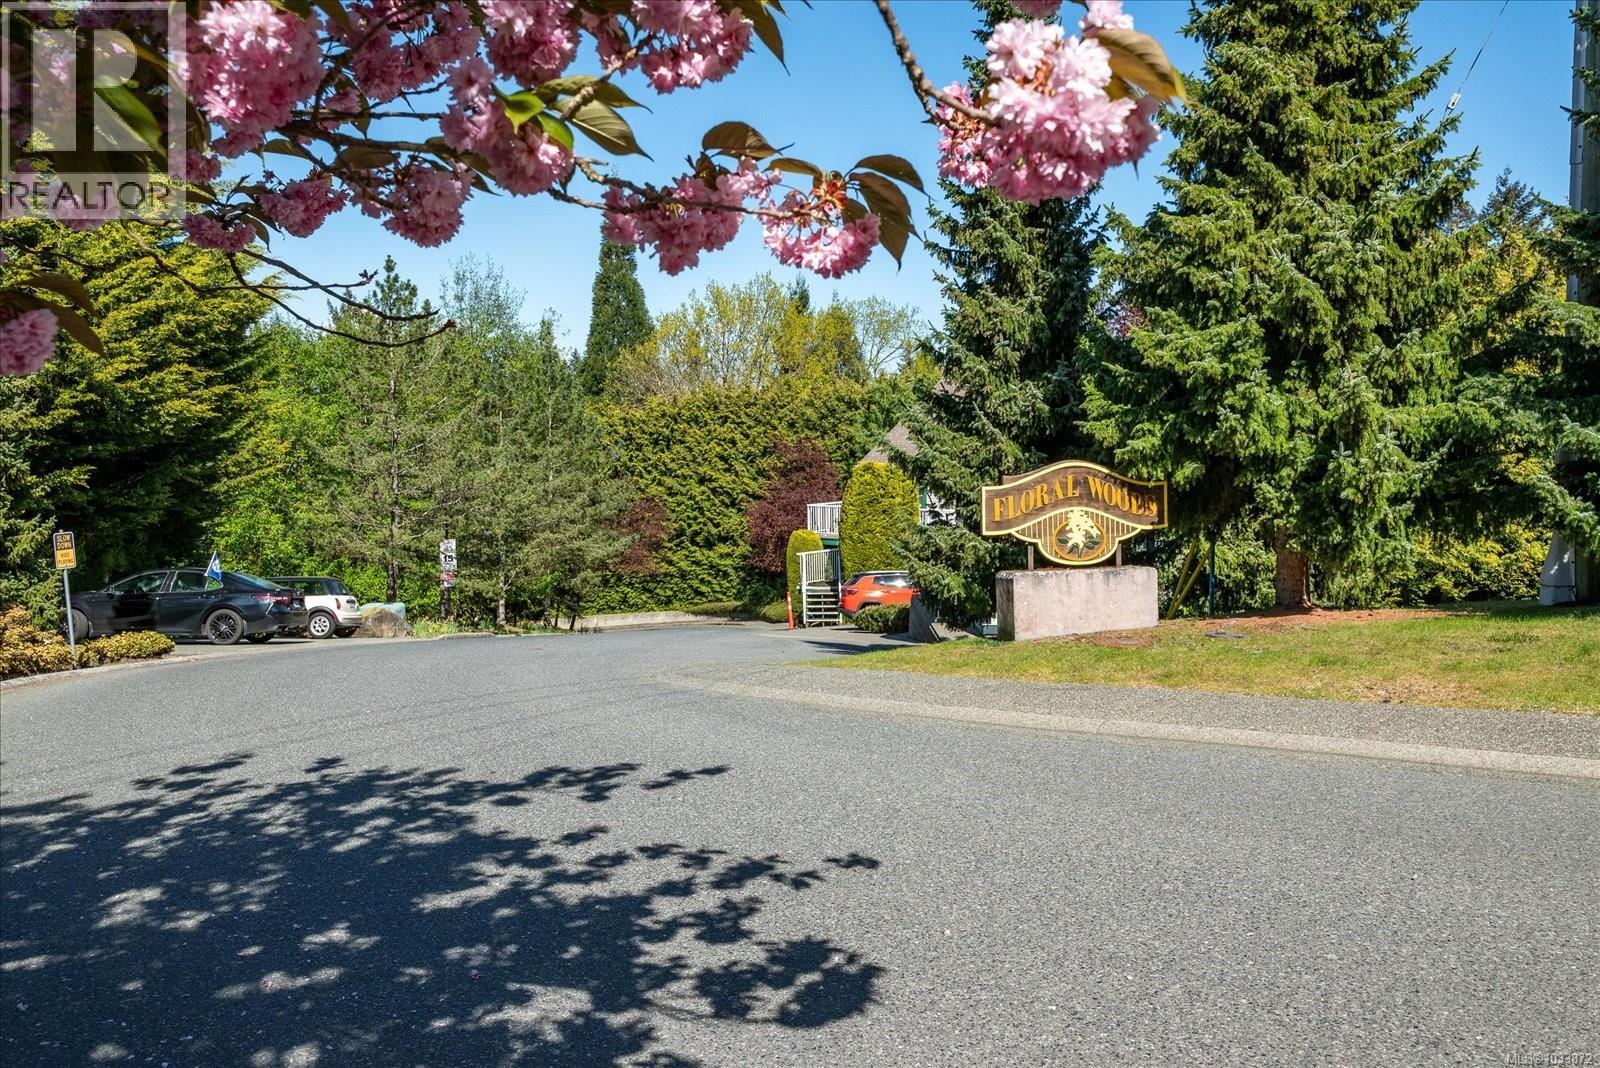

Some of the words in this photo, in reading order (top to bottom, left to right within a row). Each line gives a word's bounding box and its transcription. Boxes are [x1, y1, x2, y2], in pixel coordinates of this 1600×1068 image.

[993, 475, 1080, 522] FLORAL
[1086, 475, 1158, 517] WOODS
[57, 541, 72, 549] DOWN
[443, 554, 454, 562] 15
